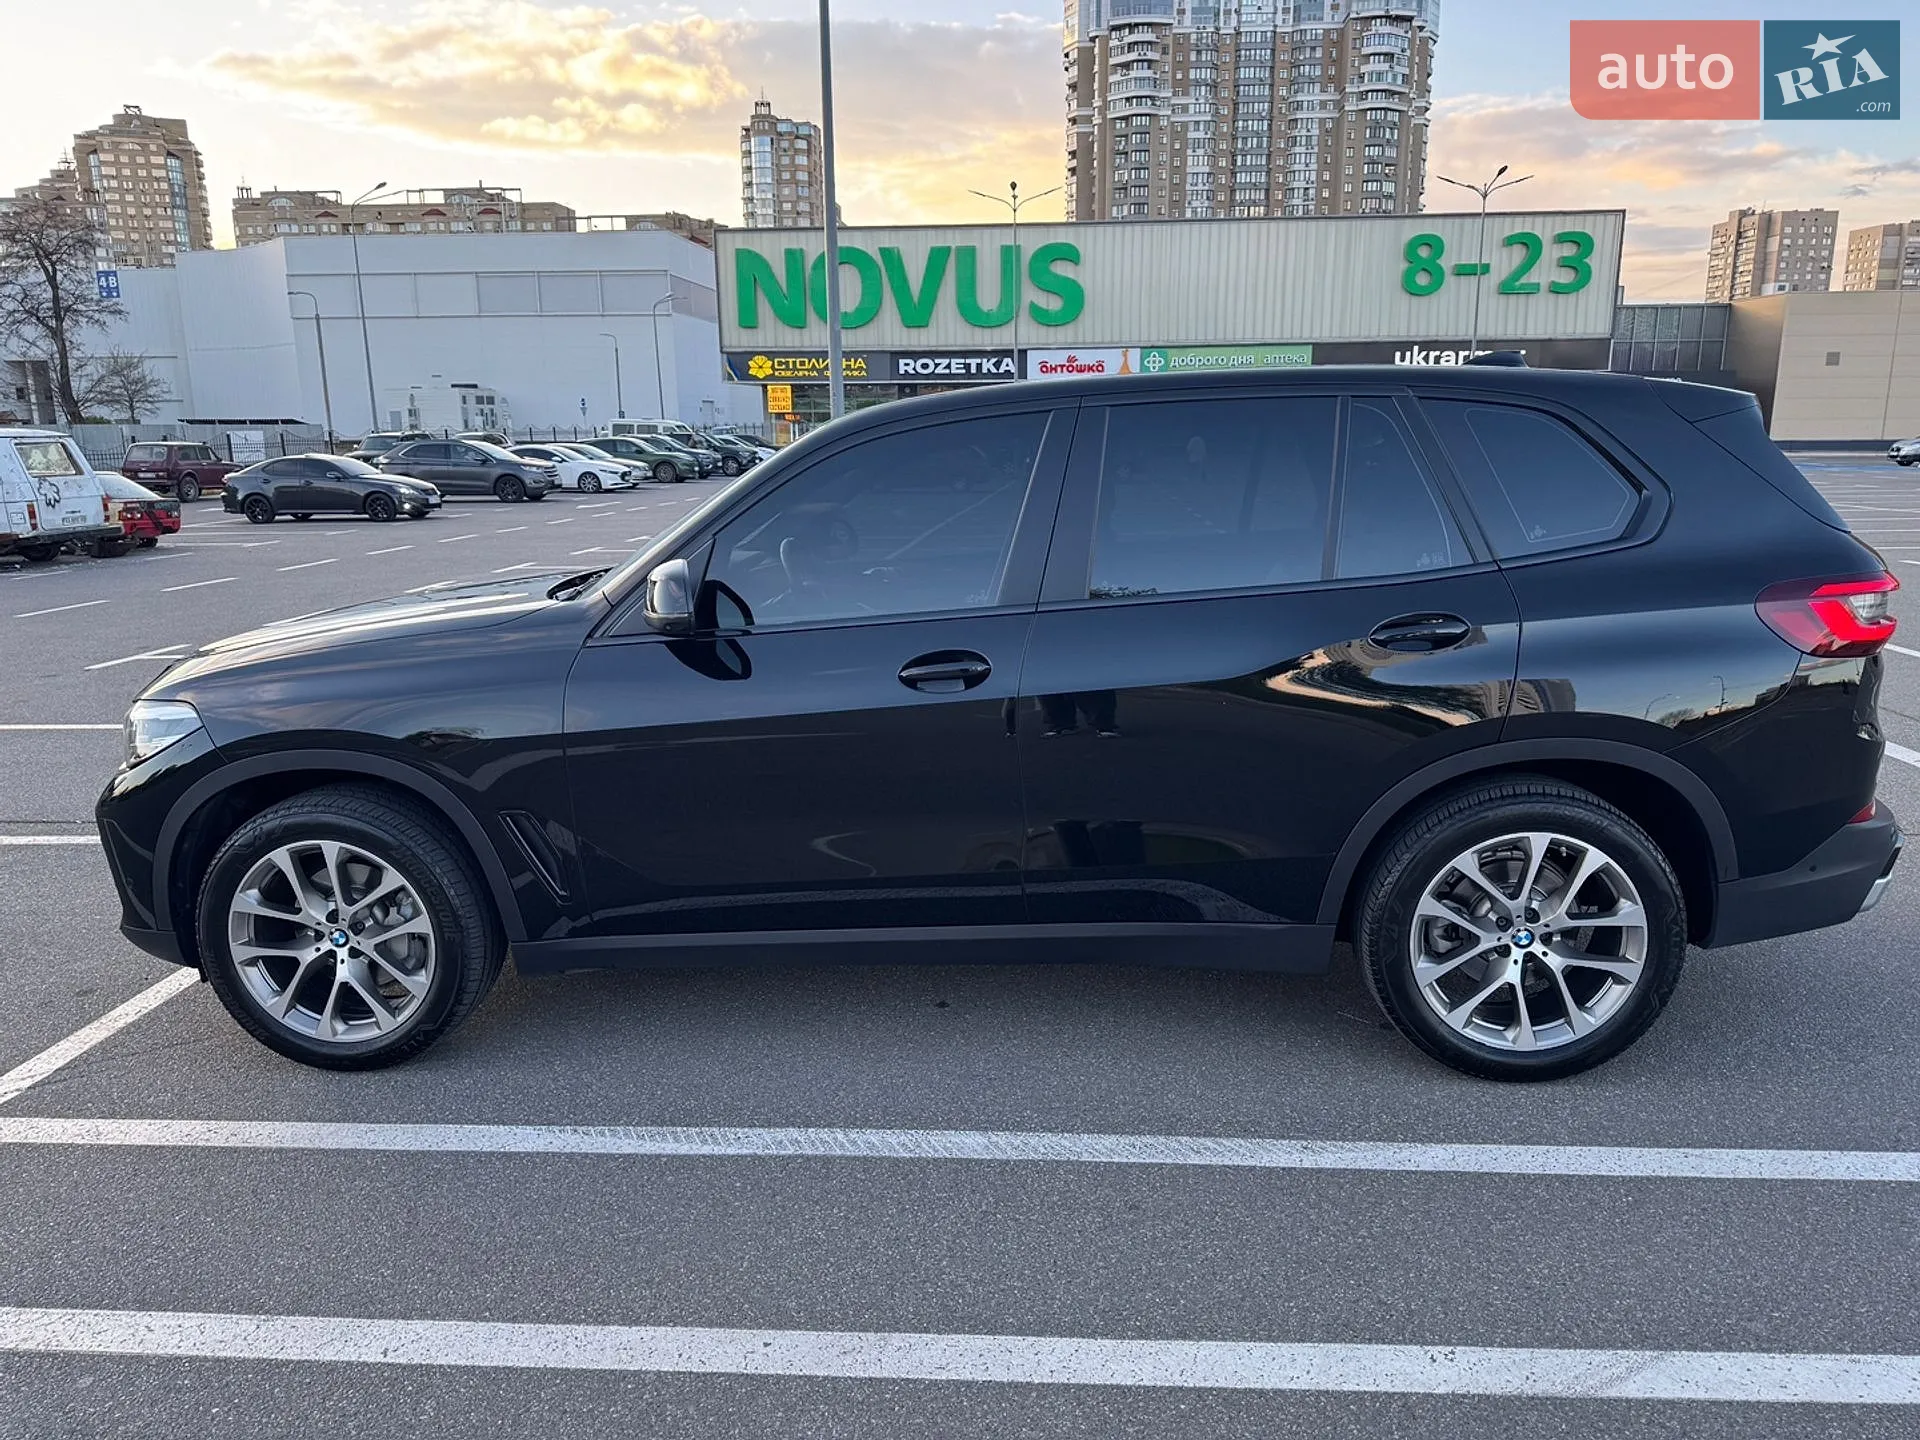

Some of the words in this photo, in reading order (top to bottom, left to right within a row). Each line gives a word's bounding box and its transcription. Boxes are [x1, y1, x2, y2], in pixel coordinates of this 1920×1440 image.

[1402, 230, 1595, 296] 8-23
[735, 242, 1085, 328] NOVUS
[774, 358, 867, 369] СТОЛИНА
[898, 357, 1015, 375] ROZETKA
[1170, 354, 1227, 367] доброго
[1229, 354, 1255, 367] дня
[1263, 353, 1307, 365] аптека
